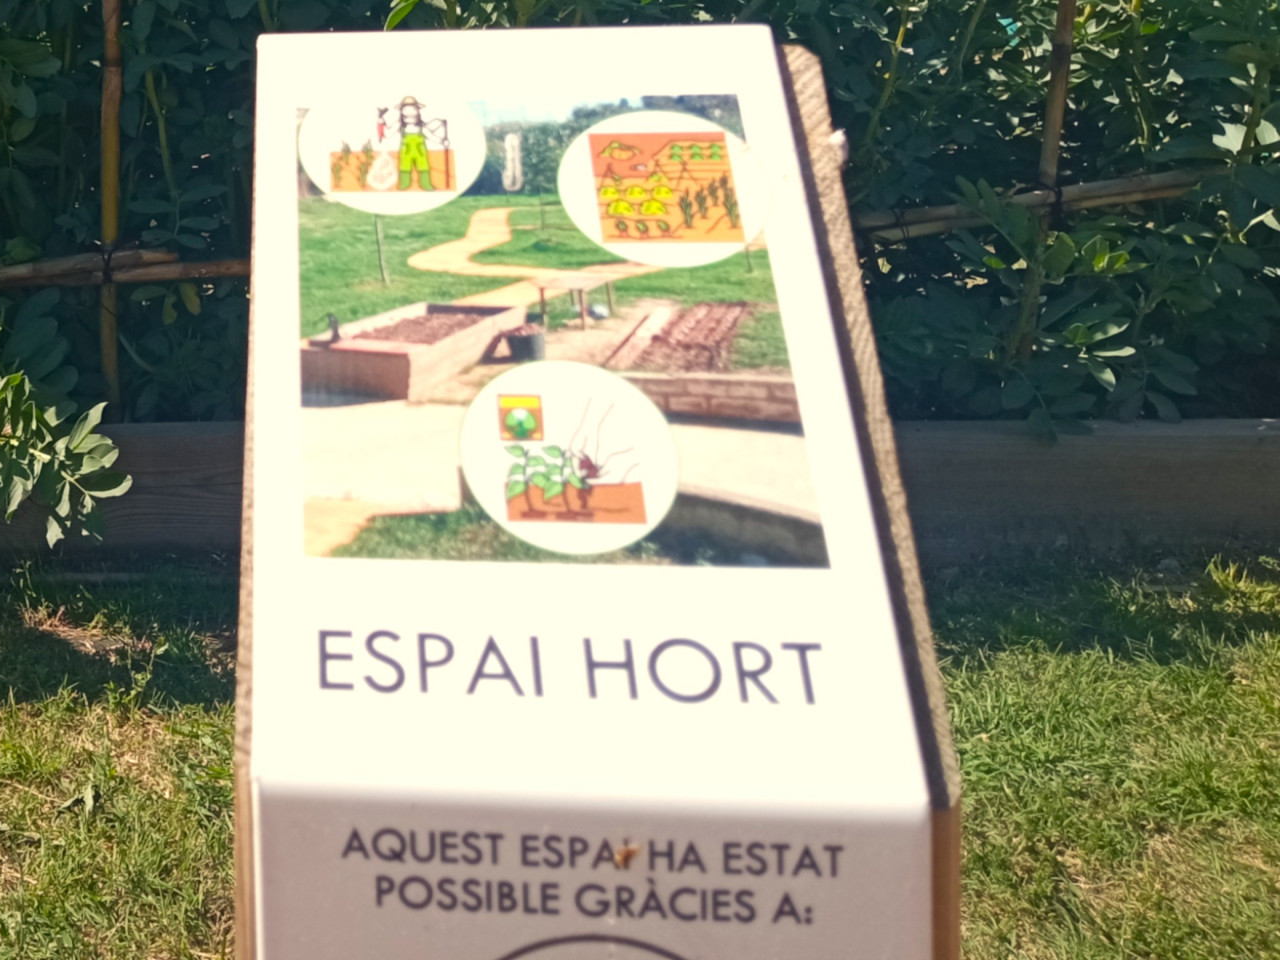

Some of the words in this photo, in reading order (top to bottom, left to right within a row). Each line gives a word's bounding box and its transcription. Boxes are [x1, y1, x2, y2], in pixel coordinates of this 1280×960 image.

[318, 629, 544, 697] ESPAI
[583, 637, 822, 705] HORT
[341, 827, 504, 865] AQUEST
[648, 839, 707, 875] HA
[723, 842, 844, 878] ESTAT
[375, 875, 560, 915] POSSIBLE
[574, 877, 757, 924] GRÀCIES
[772, 892, 813, 926] A:
